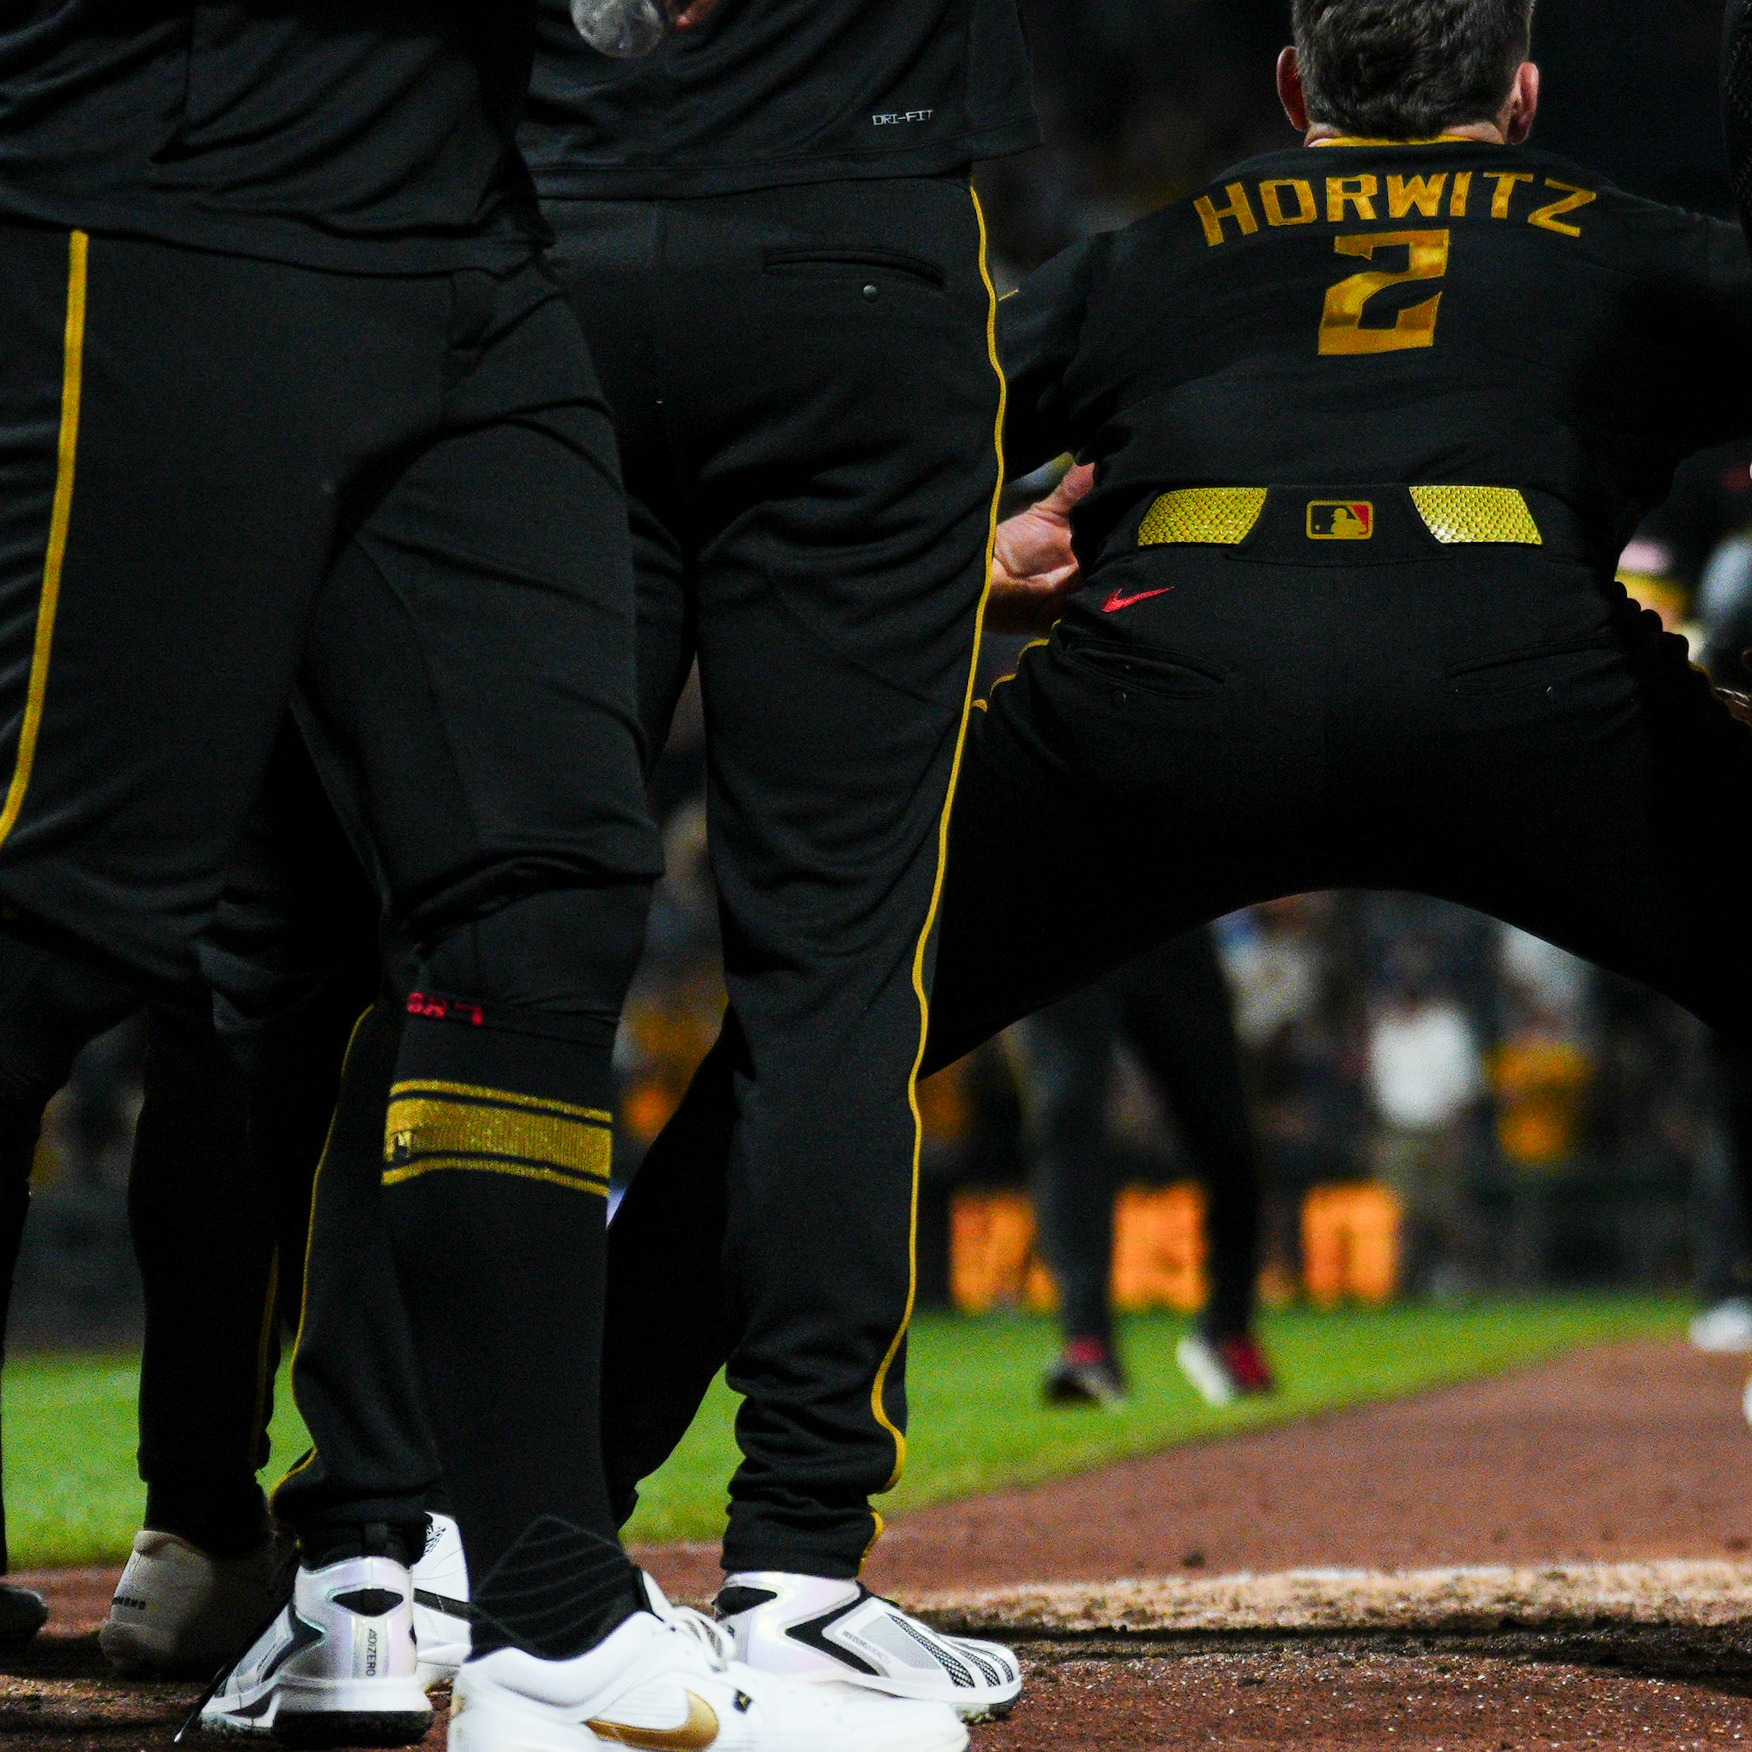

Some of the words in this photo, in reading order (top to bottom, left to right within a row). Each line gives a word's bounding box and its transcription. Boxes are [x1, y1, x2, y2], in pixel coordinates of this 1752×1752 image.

[871, 109, 934, 126] DRI-FIT
[1193, 171, 1597, 247] HORWITZ
[1317, 228, 1450, 356] 2
